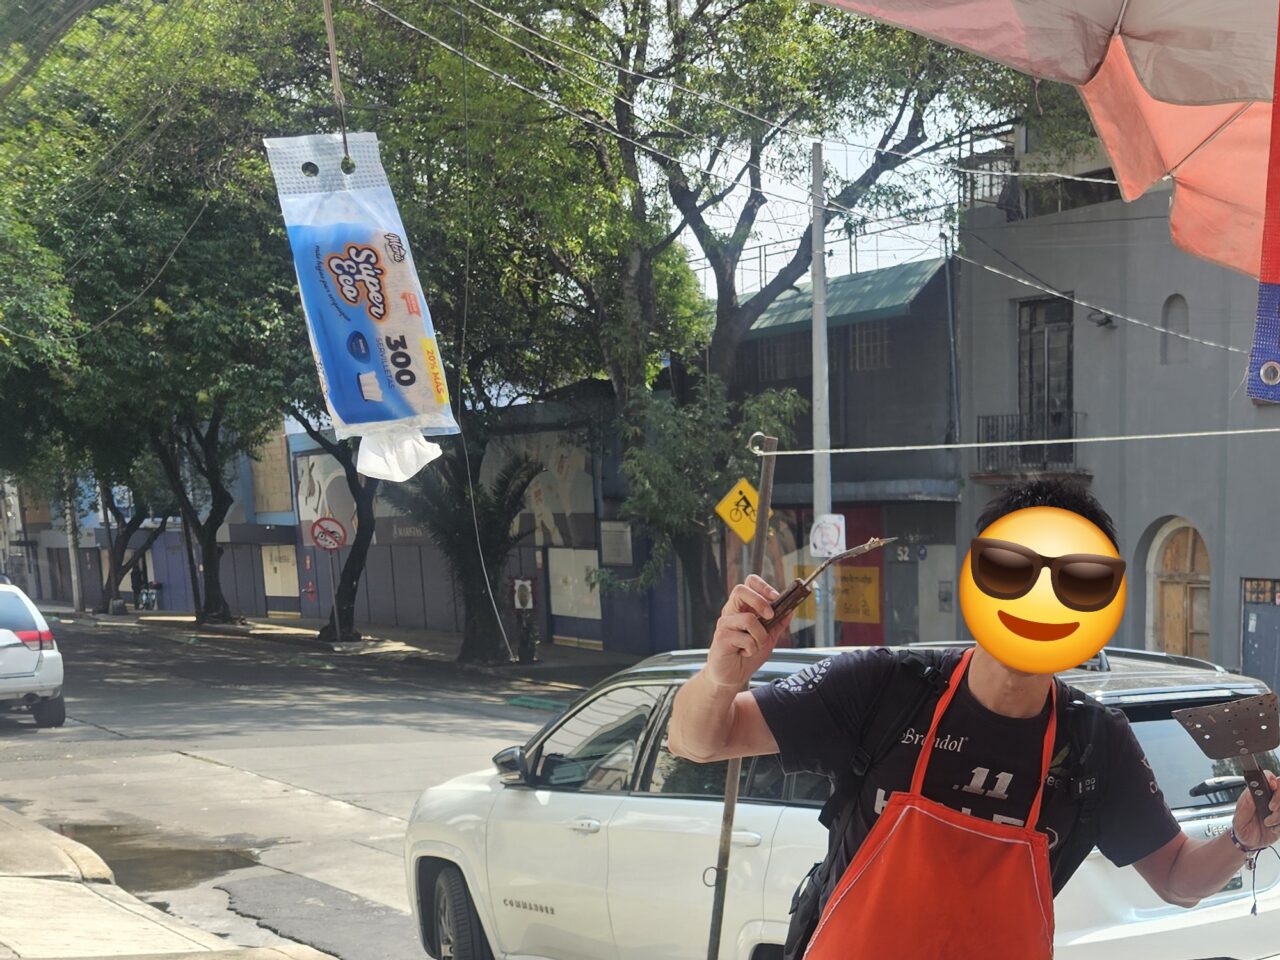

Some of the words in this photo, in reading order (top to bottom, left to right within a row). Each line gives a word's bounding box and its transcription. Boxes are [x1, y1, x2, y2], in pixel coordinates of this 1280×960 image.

[328, 257, 360, 303] Eco
[376, 338, 395, 389] SERVILLETAS
[385, 335, 416, 387] 300
[897, 546, 909, 561] 52
